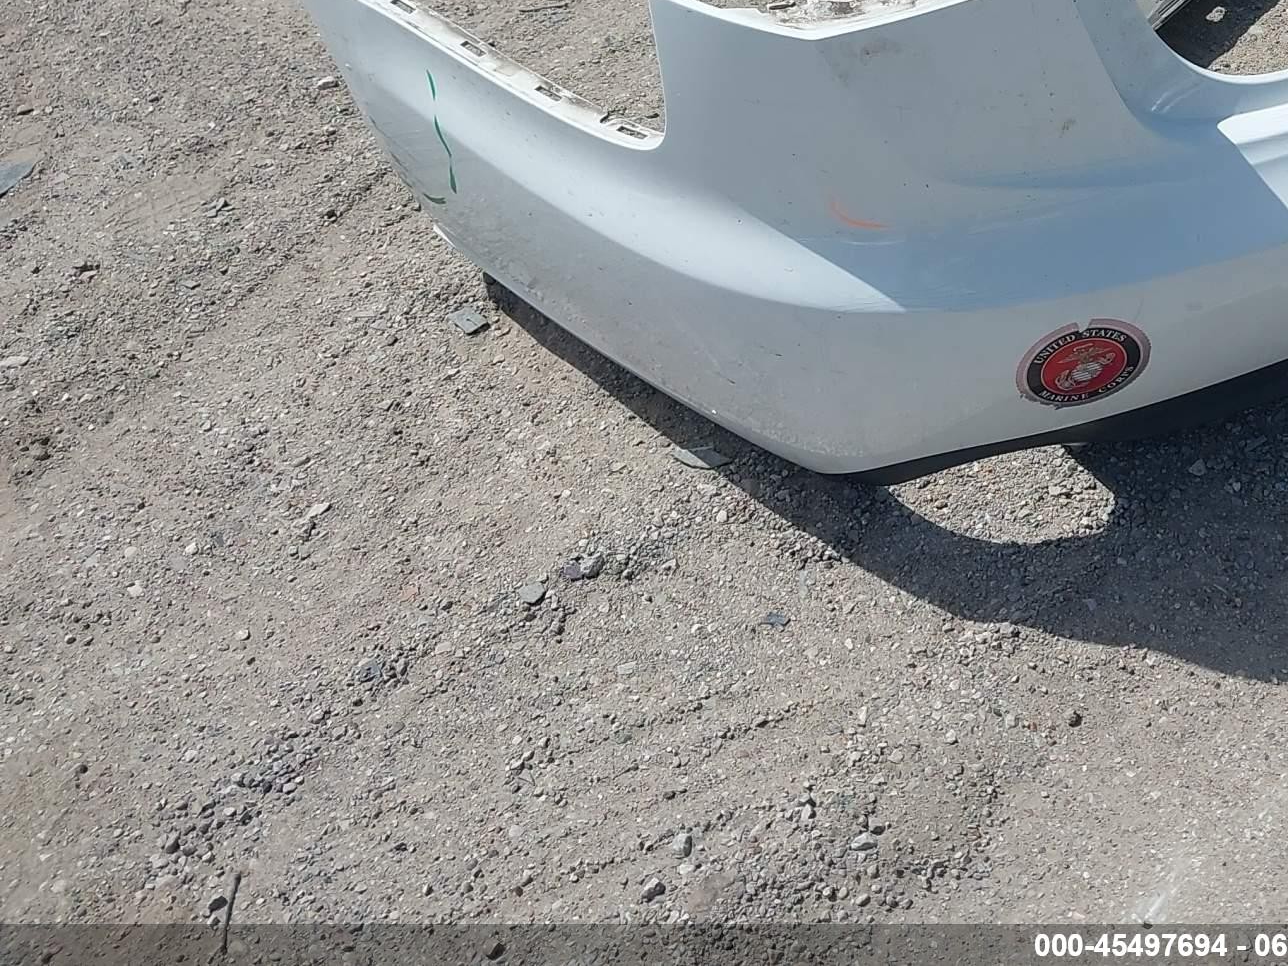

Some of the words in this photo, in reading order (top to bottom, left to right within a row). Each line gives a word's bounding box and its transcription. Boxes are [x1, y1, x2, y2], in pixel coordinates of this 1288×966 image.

[1034, 333, 1076, 365] UNITED
[1081, 328, 1127, 343] STATES
[1038, 389, 1089, 403] MARINE
[1098, 366, 1134, 393] CORPS
